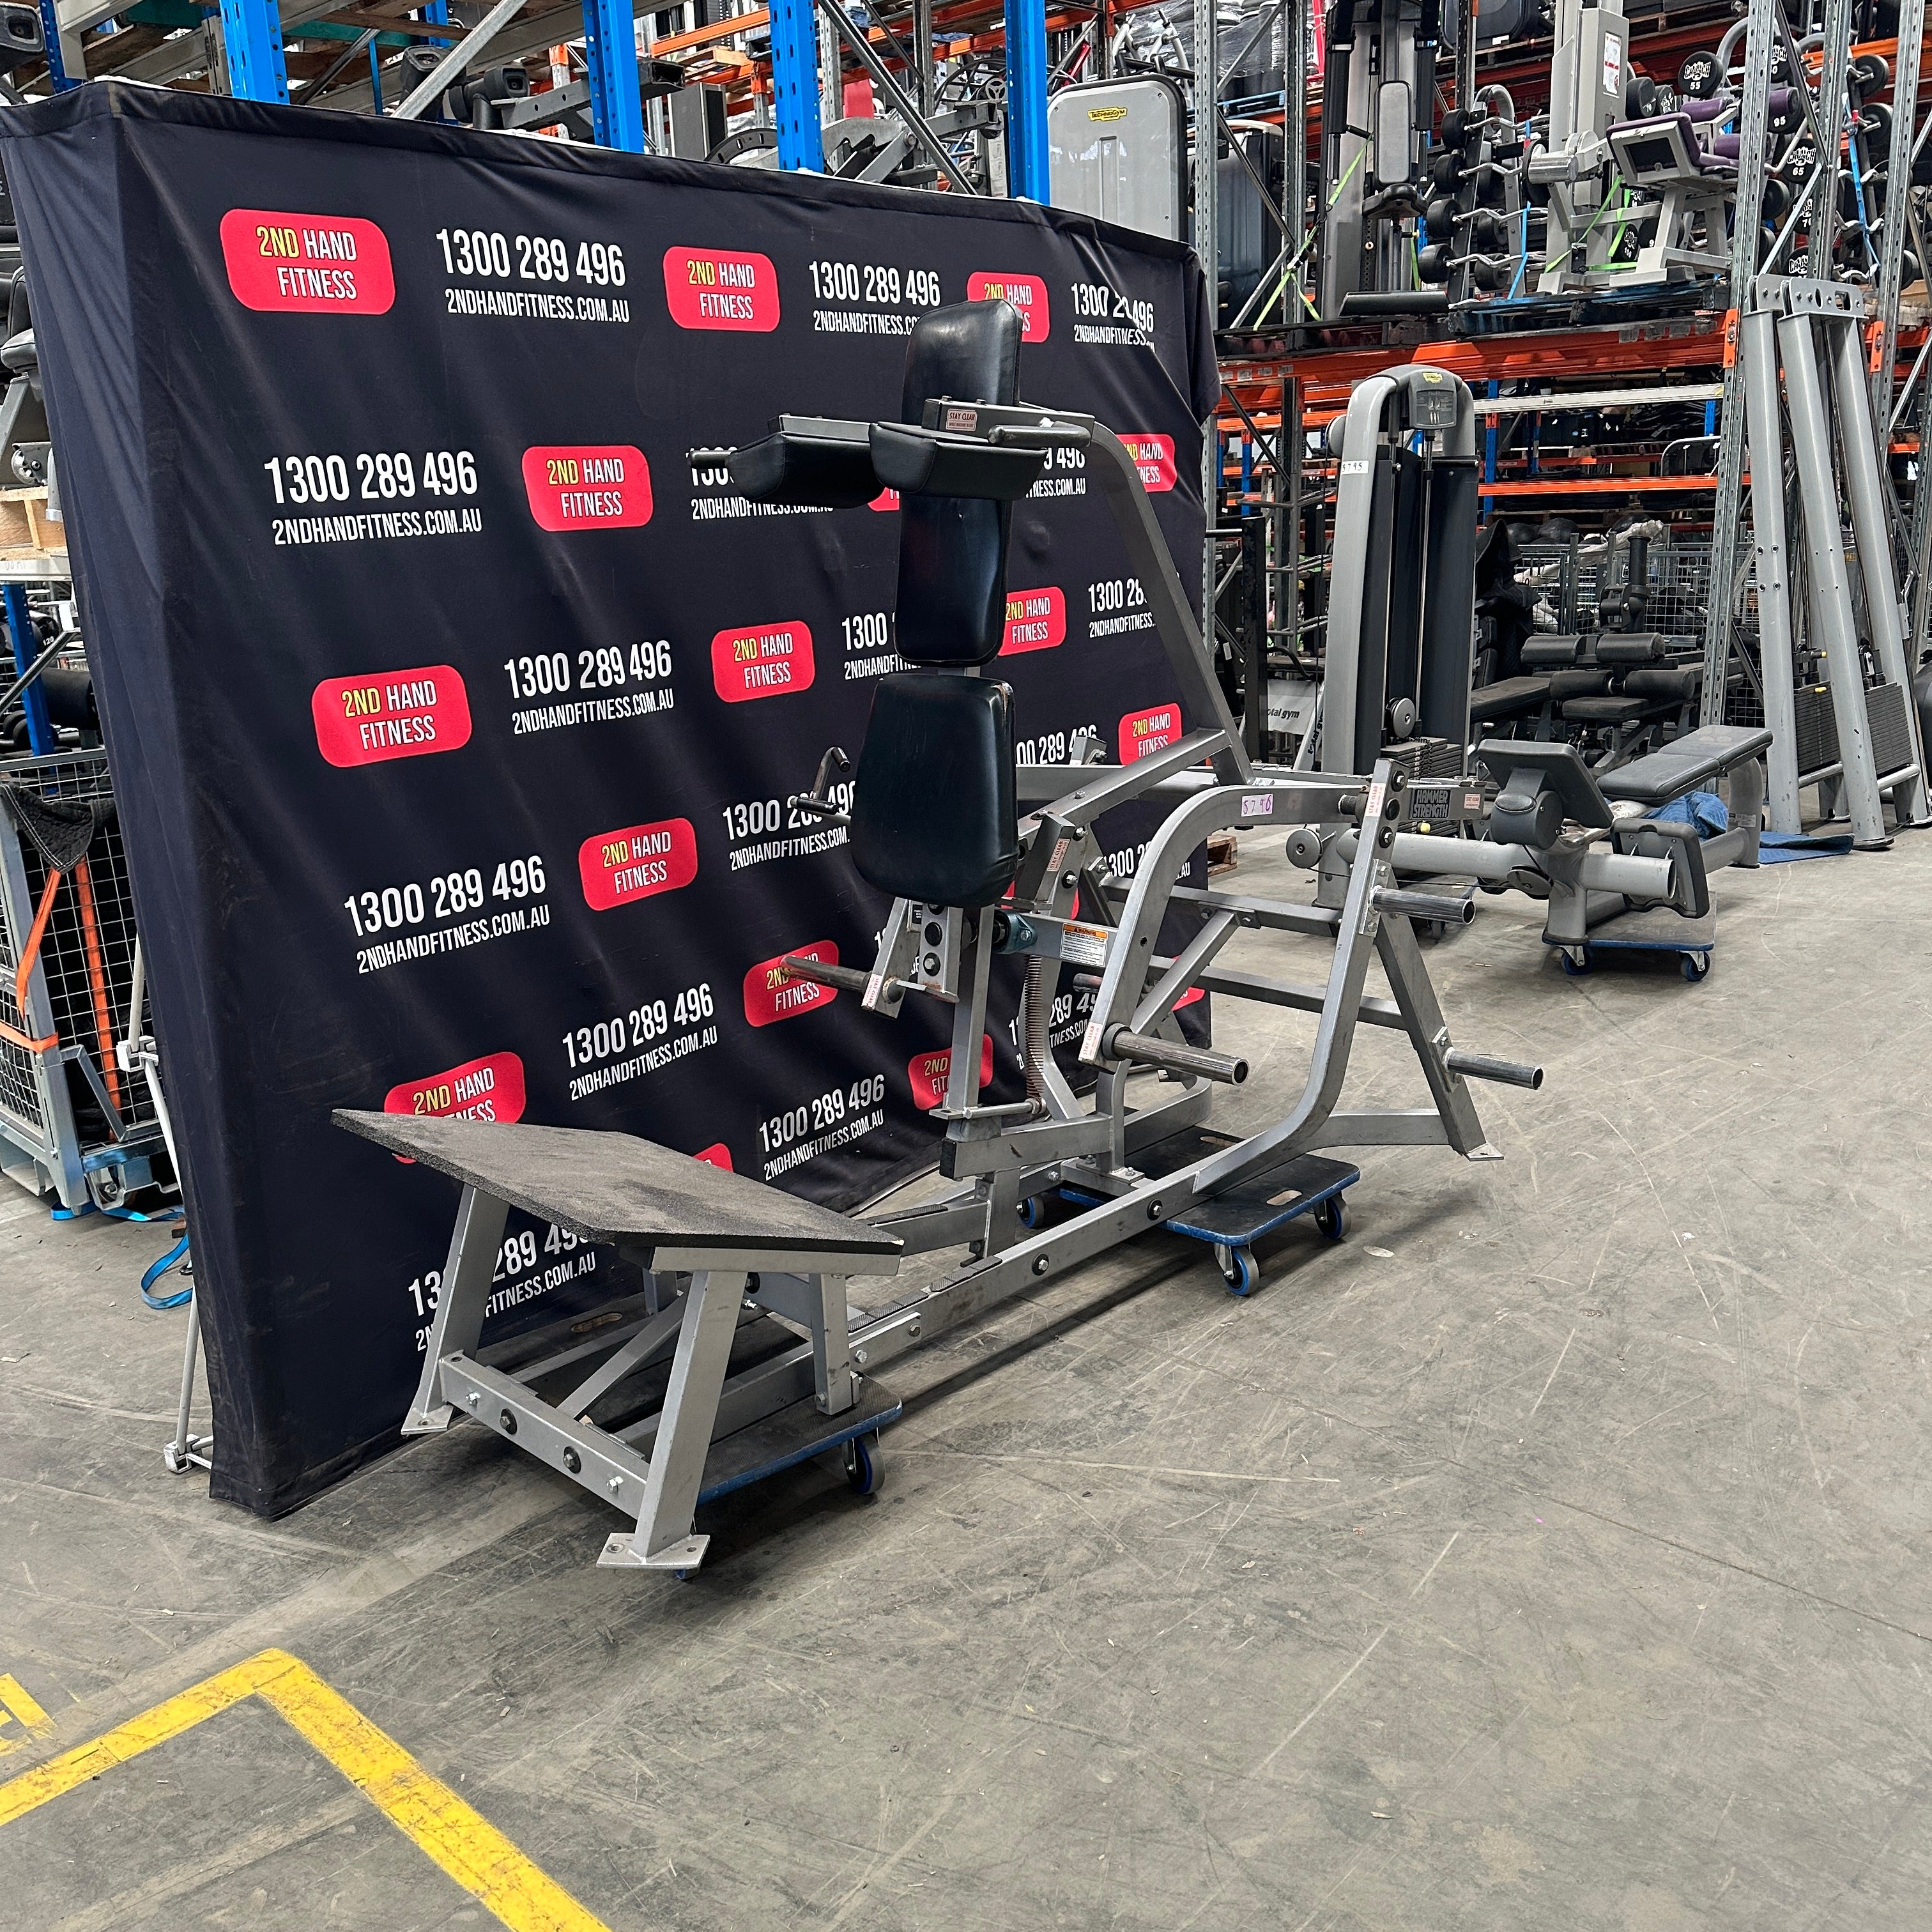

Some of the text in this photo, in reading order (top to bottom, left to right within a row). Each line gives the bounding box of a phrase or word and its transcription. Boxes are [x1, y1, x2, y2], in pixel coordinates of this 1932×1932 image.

[1684, 61, 1711, 80] CRUNCH
[1690, 81, 1701, 90] 55
[1774, 116, 1786, 127] 95
[1792, 167, 1804, 176] 65
[256, 226, 356, 261] 2ND HAND
[436, 229, 625, 287] 1300 289 496
[277, 266, 356, 300] FITNESS
[687, 259, 755, 289] 2ND HAND
[809, 261, 940, 306] 1300 289 496
[445, 289, 630, 323] 2NDHANDFITNESS.COM.AU
[700, 292, 753, 319] FITNESS
[984, 283, 1032, 305] 2ND HAND
[1071, 283, 1108, 317] 1300
[1132, 300, 1154, 333] 496
[813, 310, 920, 335] 2NDHANDFITNESS.C
[1124, 443, 1163, 461] ND HAND
[264, 451, 478, 504] 1300 289 496
[546, 459, 624, 486] 2ND HAND
[560, 492, 623, 518] FITNESS
[272, 509, 482, 546] 2NDHANDFITNESS.COM.AU
[1006, 597, 1050, 621] 2ND HAND
[1088, 578, 1147, 613] 1300 28
[733, 632, 793, 663] 2ND HAND
[841, 612, 887, 650] 1300
[1012, 621, 1048, 644] FITNESS
[504, 640, 672, 700] 1300 289 496
[744, 661, 792, 689] FITNESS
[341, 679, 437, 719] 2ND HAND
[512, 689, 674, 735] 2NDHANDFITNESS.COM.AU
[1268, 708, 1300, 719] otal gym
[358, 715, 436, 751] FITNESS
[1132, 712, 1170, 737] 2ND HAND
[1038, 732, 1065, 765] 289
[1138, 735, 1169, 757] FITNESS
[1243, 795, 1271, 815] 5796
[1413, 804, 1448, 818] STRENGTH
[1416, 790, 1448, 804] HAMMER
[723, 799, 780, 840] 1300
[602, 831, 672, 870] 2ND HAND
[1104, 847, 1134, 877] 300
[614, 860, 668, 894] FITNESS
[344, 855, 546, 937] 1300 289 496
[356, 905, 550, 974] 2NDHANDFITNESS.COM.AU
[775, 981, 820, 1011] FITNESS
[562, 983, 714, 1069] 1300 289 496
[569, 1026, 717, 1101] 2NDHANDFITNESS.COM.AU
[924, 1057, 948, 1076] 2ND
[413, 1067, 494, 1116] 2ND HAND
[759, 1108, 807, 1153] 1300
[812, 1089, 845, 1129] 289
[848, 1075, 885, 1112] 496
[763, 1108, 884, 1182] 2NDHANDFITNESS.COM.AU
